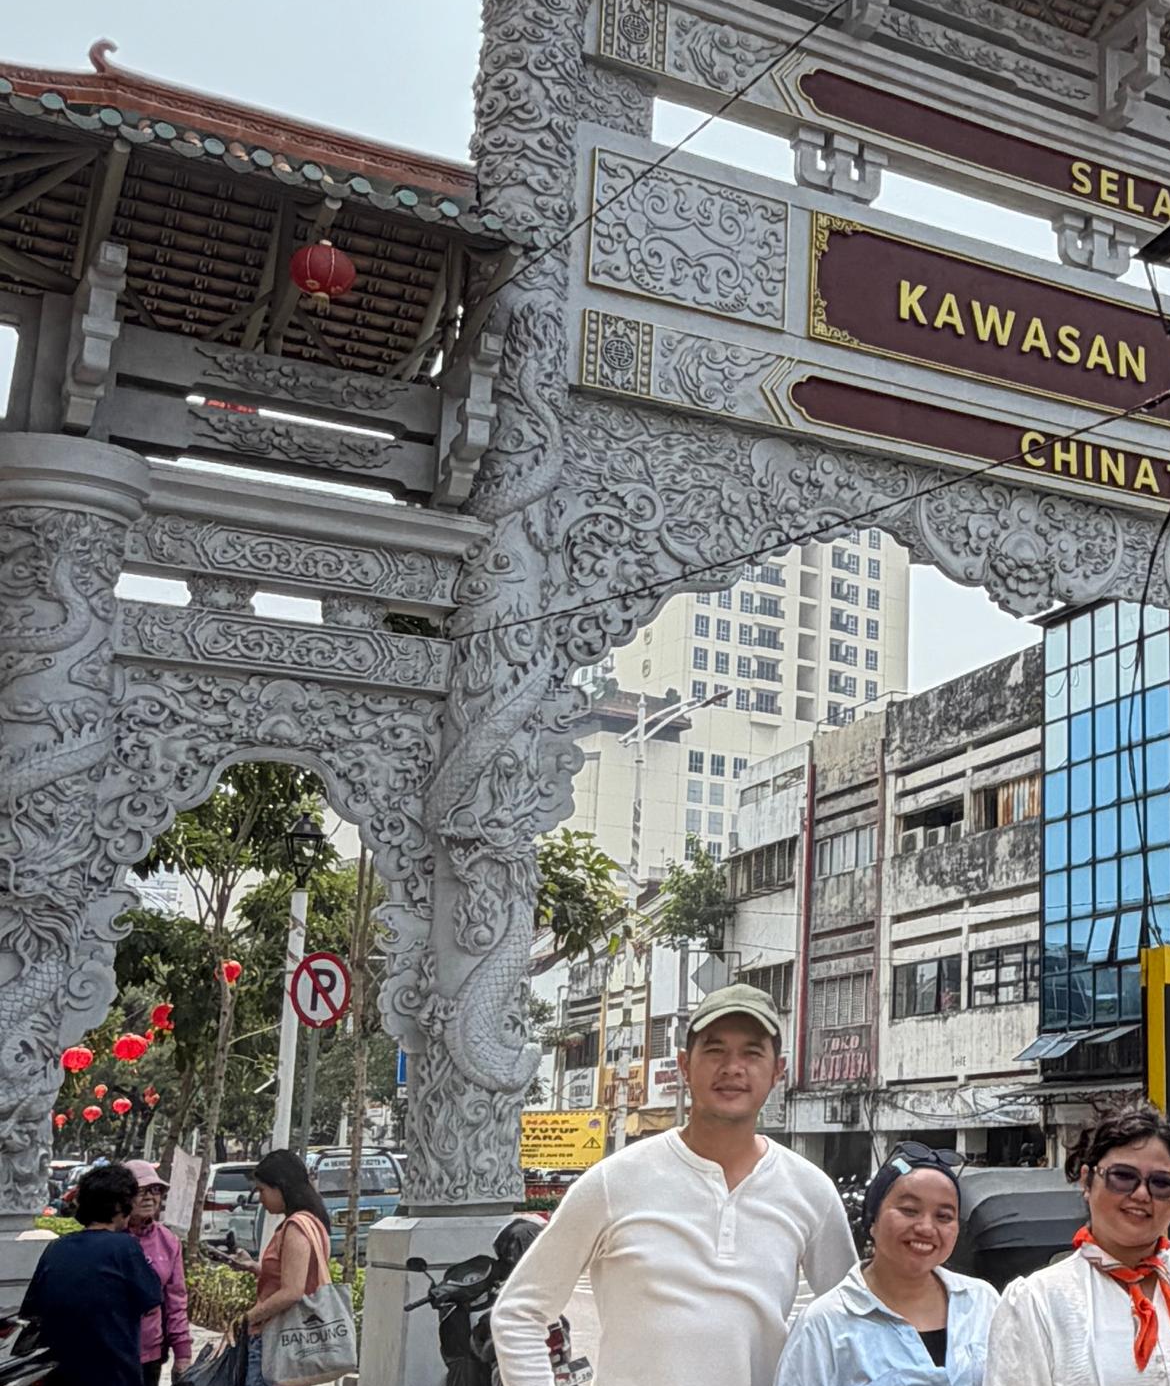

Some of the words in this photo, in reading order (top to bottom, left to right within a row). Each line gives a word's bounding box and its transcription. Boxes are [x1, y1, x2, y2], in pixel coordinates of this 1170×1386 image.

[899, 279, 1148, 383] KAWASAN
[823, 1035, 860, 1052] TOKO
[281, 1324, 348, 1347] BANDUNG
